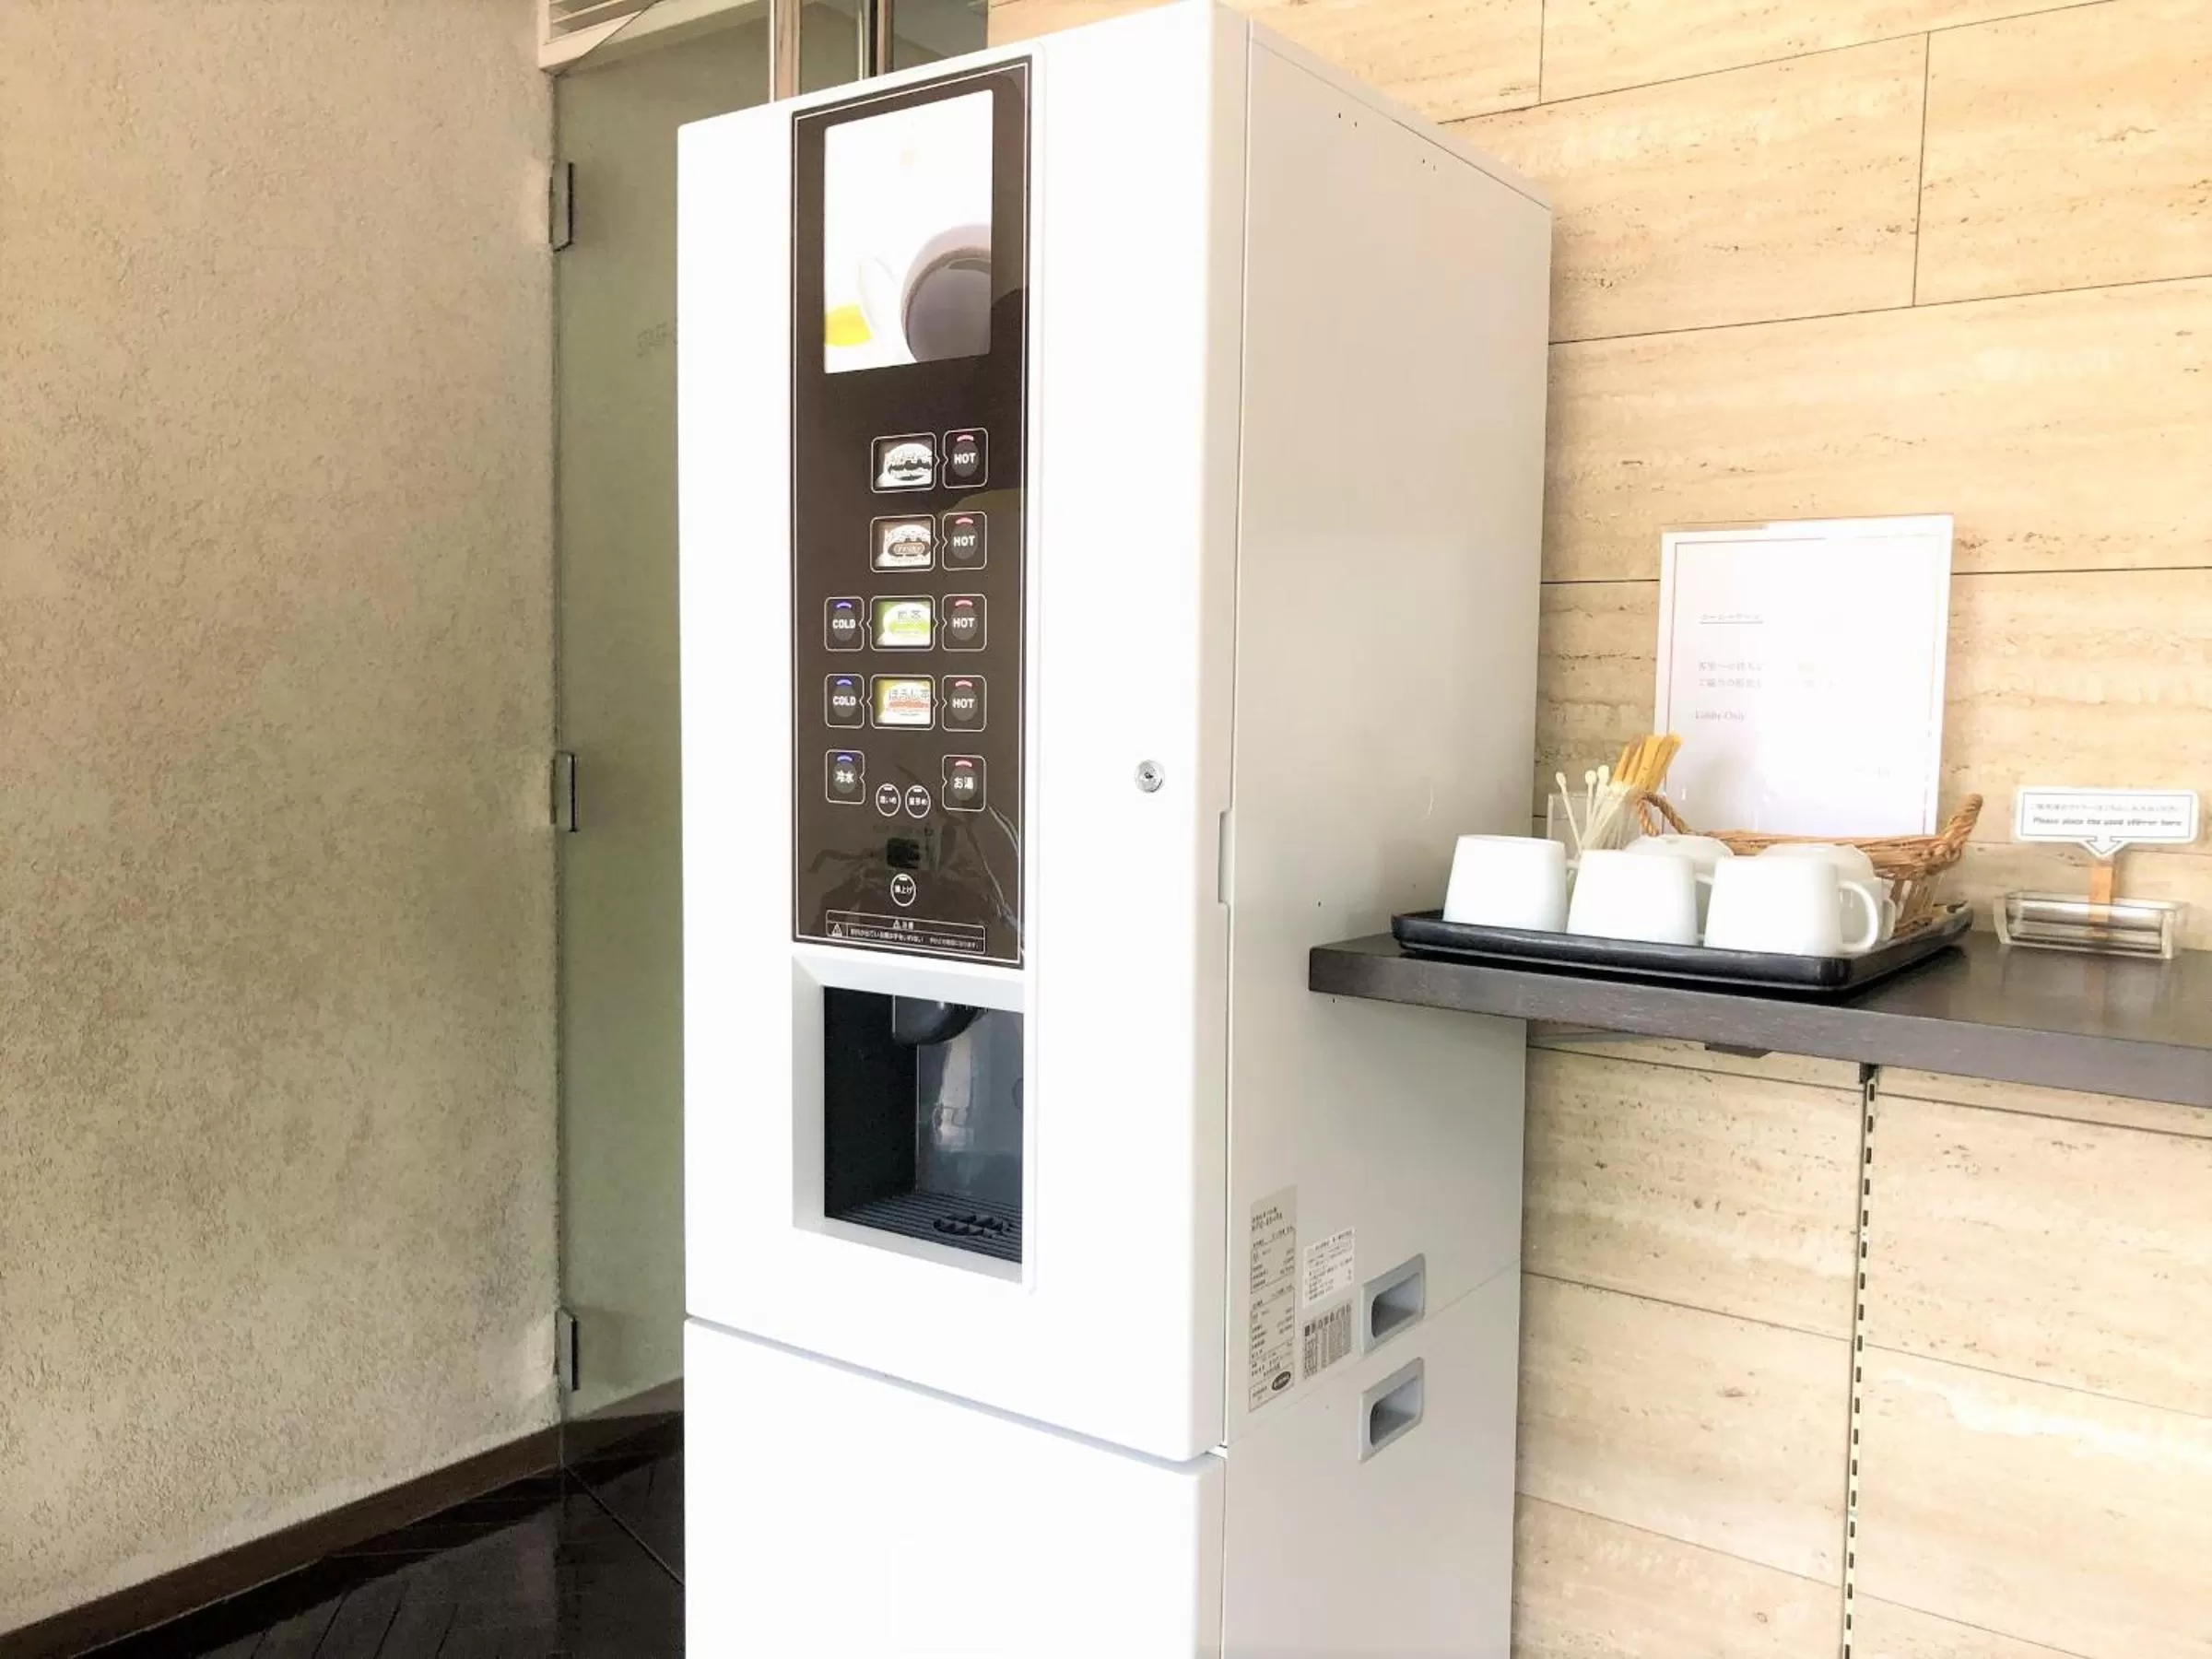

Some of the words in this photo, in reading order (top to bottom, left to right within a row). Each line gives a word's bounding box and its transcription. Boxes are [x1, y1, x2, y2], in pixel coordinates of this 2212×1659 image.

[953, 452, 976, 465] HOT
[953, 535, 976, 547] HOT
[832, 618, 856, 629] COLD
[952, 617, 975, 629] HOT
[832, 695, 856, 707] COLD
[952, 697, 975, 710] HOT
